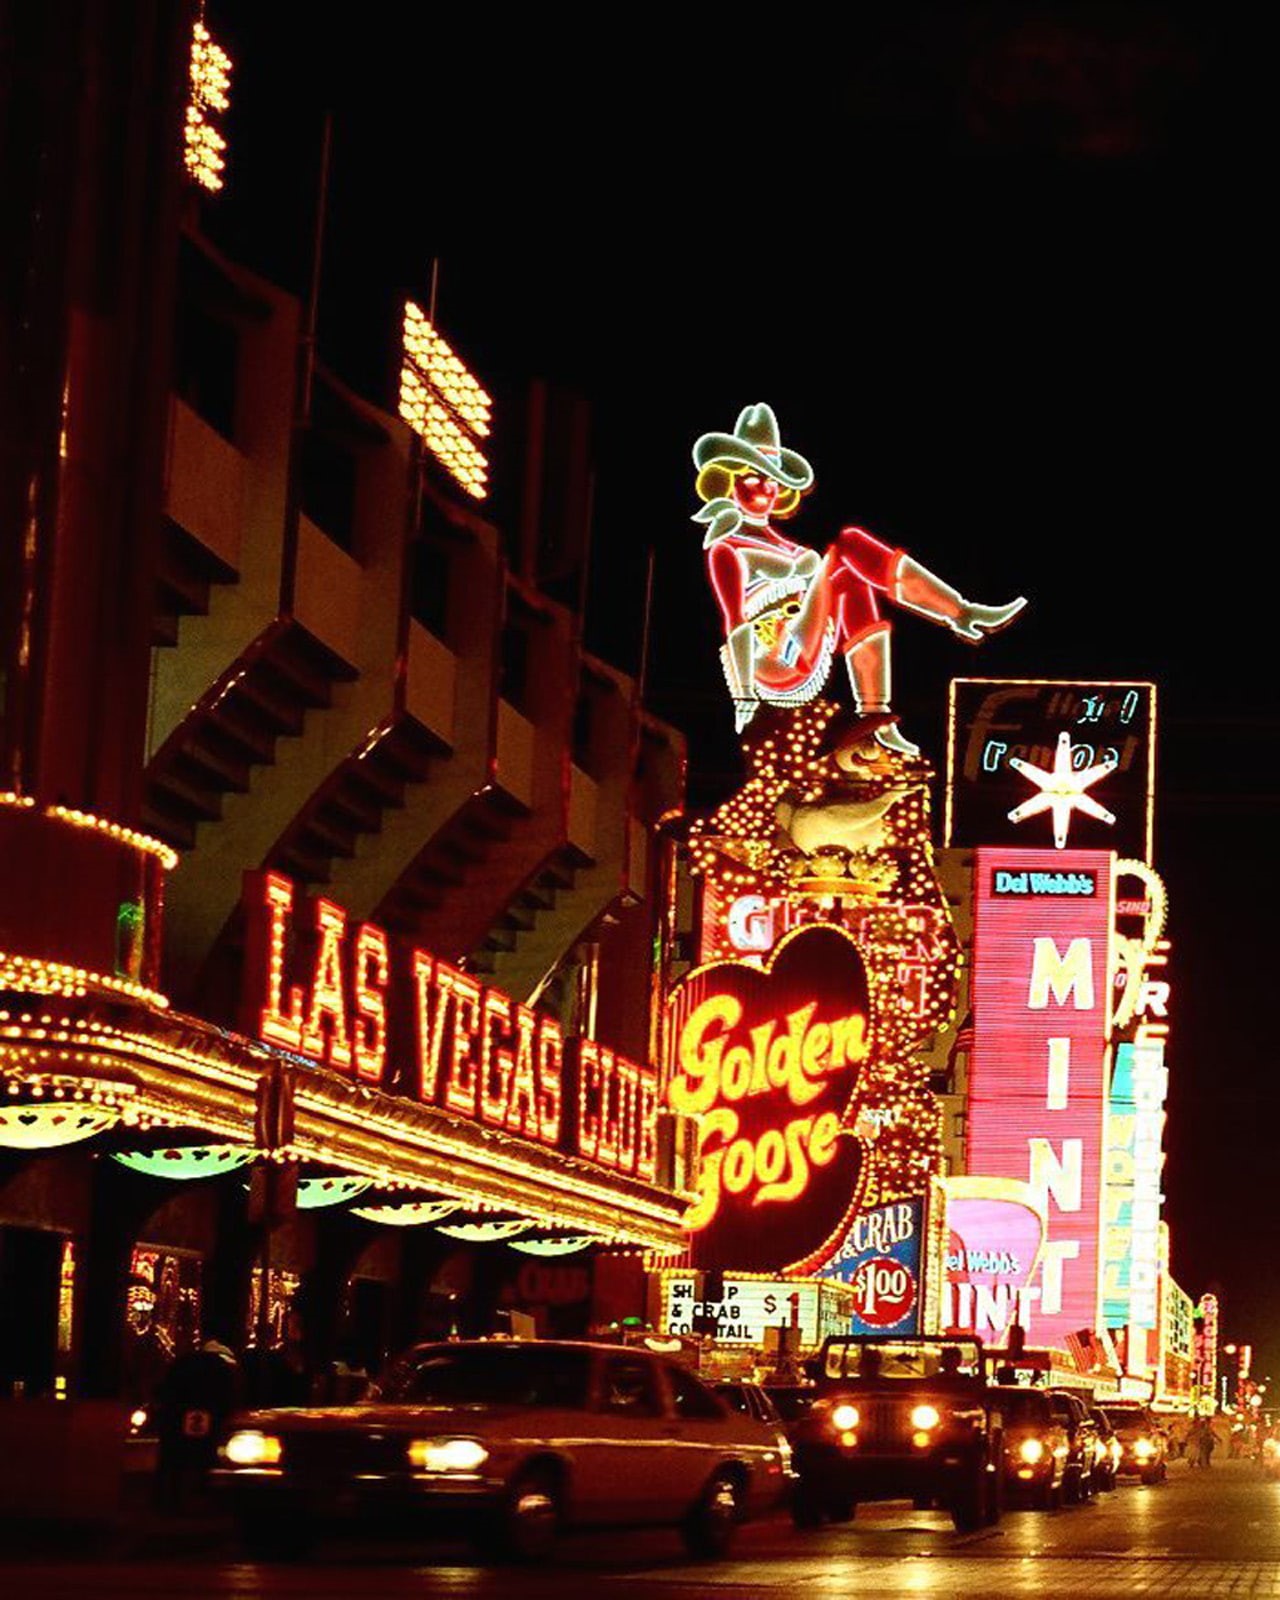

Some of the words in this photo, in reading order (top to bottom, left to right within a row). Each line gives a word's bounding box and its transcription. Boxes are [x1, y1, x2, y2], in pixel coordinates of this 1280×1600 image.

[996, 872, 1028, 892] Del
[1117, 901, 1149, 913] SINO
[260, 871, 388, 1082] LAS
[414, 947, 562, 1145] VEGAS
[578, 1037, 658, 1182] CLUB
[669, 995, 869, 1112] Golden
[1028, 938, 1095, 1314] MINT
[682, 1108, 839, 1230] Goose
[854, 1205, 913, 1253] CRAB
[669, 1323, 753, 1339] COTAIL
[692, 1304, 740, 1318] CRAB
